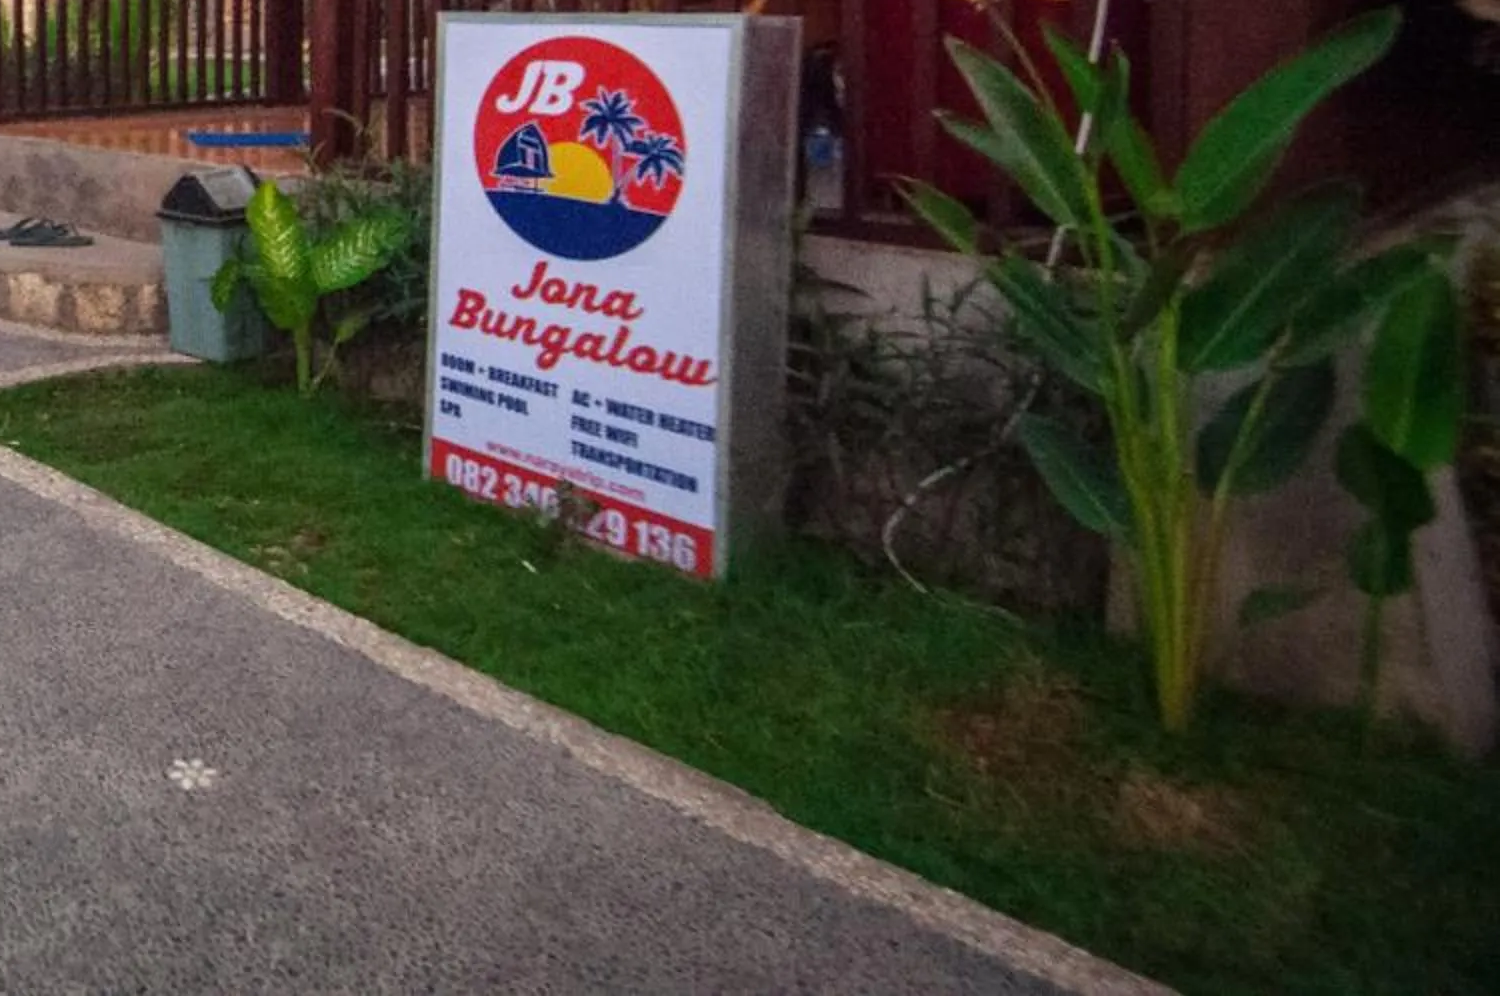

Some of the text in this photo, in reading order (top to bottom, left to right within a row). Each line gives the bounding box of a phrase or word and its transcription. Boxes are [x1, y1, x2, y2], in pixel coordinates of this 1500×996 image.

[495, 59, 586, 116] JB
[511, 260, 644, 321] Jona
[449, 288, 718, 386] Bungalow
[441, 352, 475, 375] ROOM
[488, 366, 560, 399] BREAKFAST
[440, 398, 462, 418] SPA
[498, 393, 529, 416] POOL
[570, 415, 601, 438] FREE
[571, 388, 590, 408] AC
[606, 398, 654, 426] WATER
[658, 412, 717, 442] HEATER
[571, 440, 698, 493] TRANSPORTATION
[446, 454, 498, 501] 082
[633, 520, 698, 572] 136
